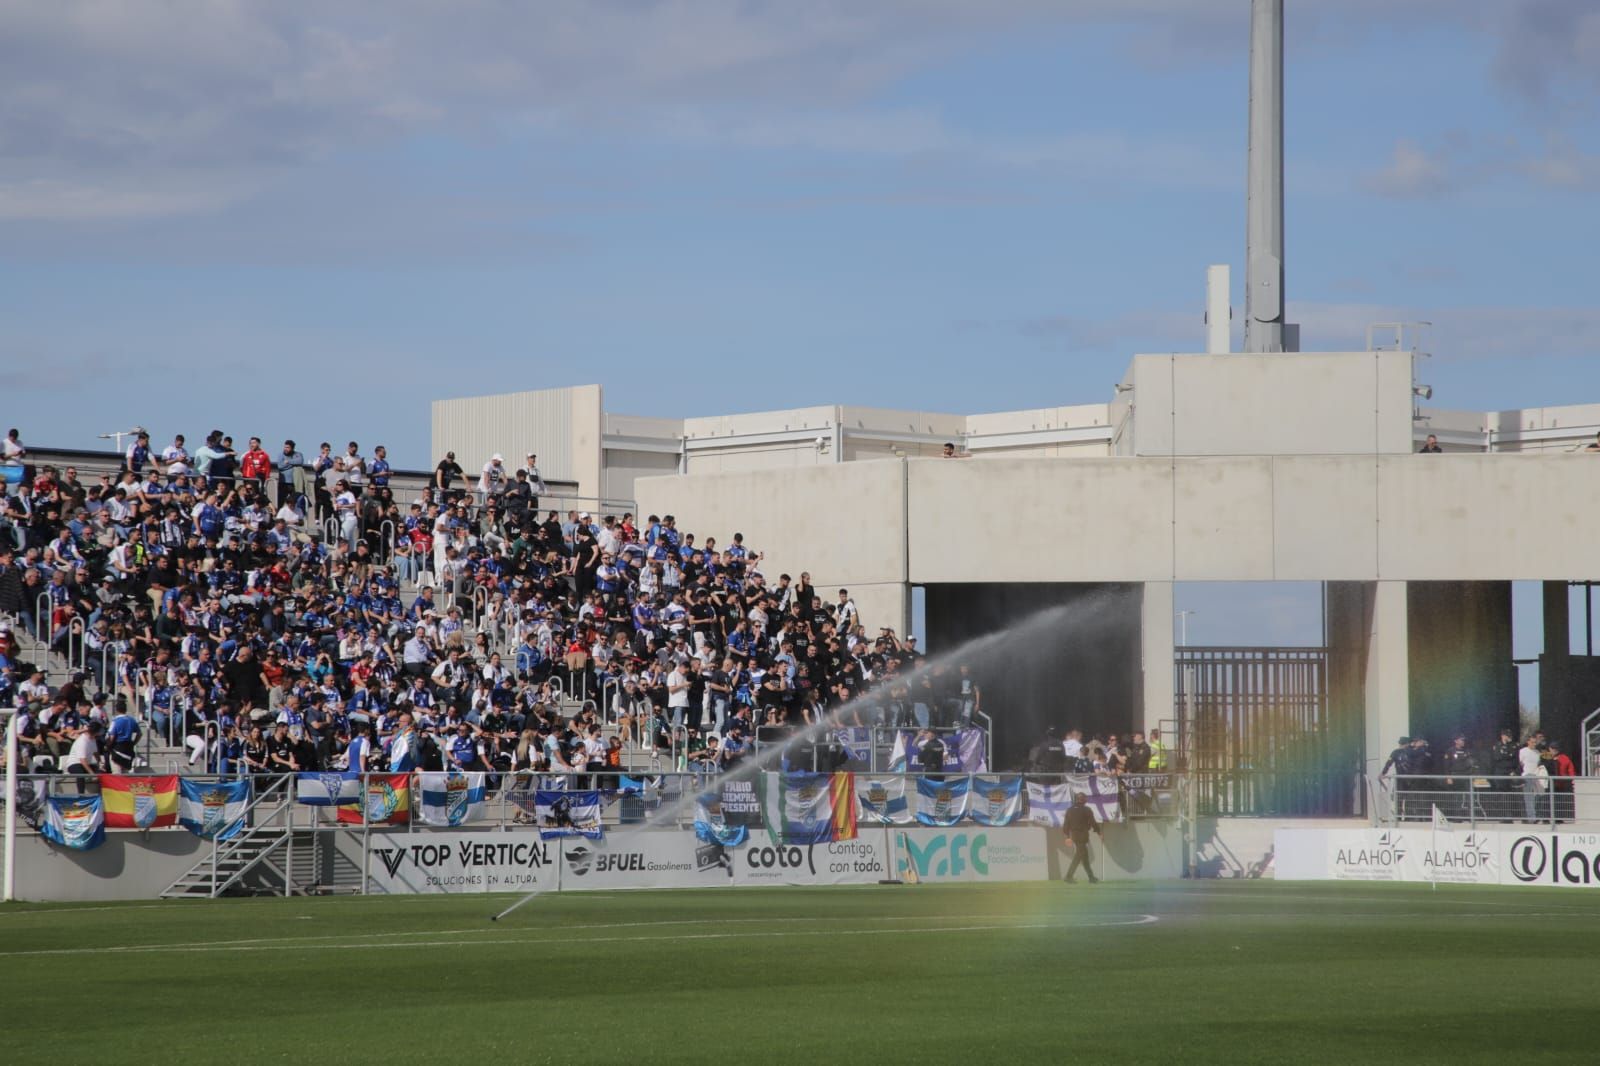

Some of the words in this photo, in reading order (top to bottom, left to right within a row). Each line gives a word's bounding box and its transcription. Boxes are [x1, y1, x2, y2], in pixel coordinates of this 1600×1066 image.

[720, 802, 760, 812] PRESENTE
[411, 845, 451, 867] TOP
[459, 841, 552, 868] VERTICAL
[747, 846, 803, 869] coto
[828, 842, 876, 858] Contigo,
[596, 853, 646, 872] BFUEL
[647, 860, 692, 872] Gasolineras
[829, 862, 850, 873] con
[854, 858, 884, 873] todo.
[426, 875, 482, 886] SOLUCIONES
[488, 874, 499, 884] EN
[504, 874, 538, 885] ALTURA
